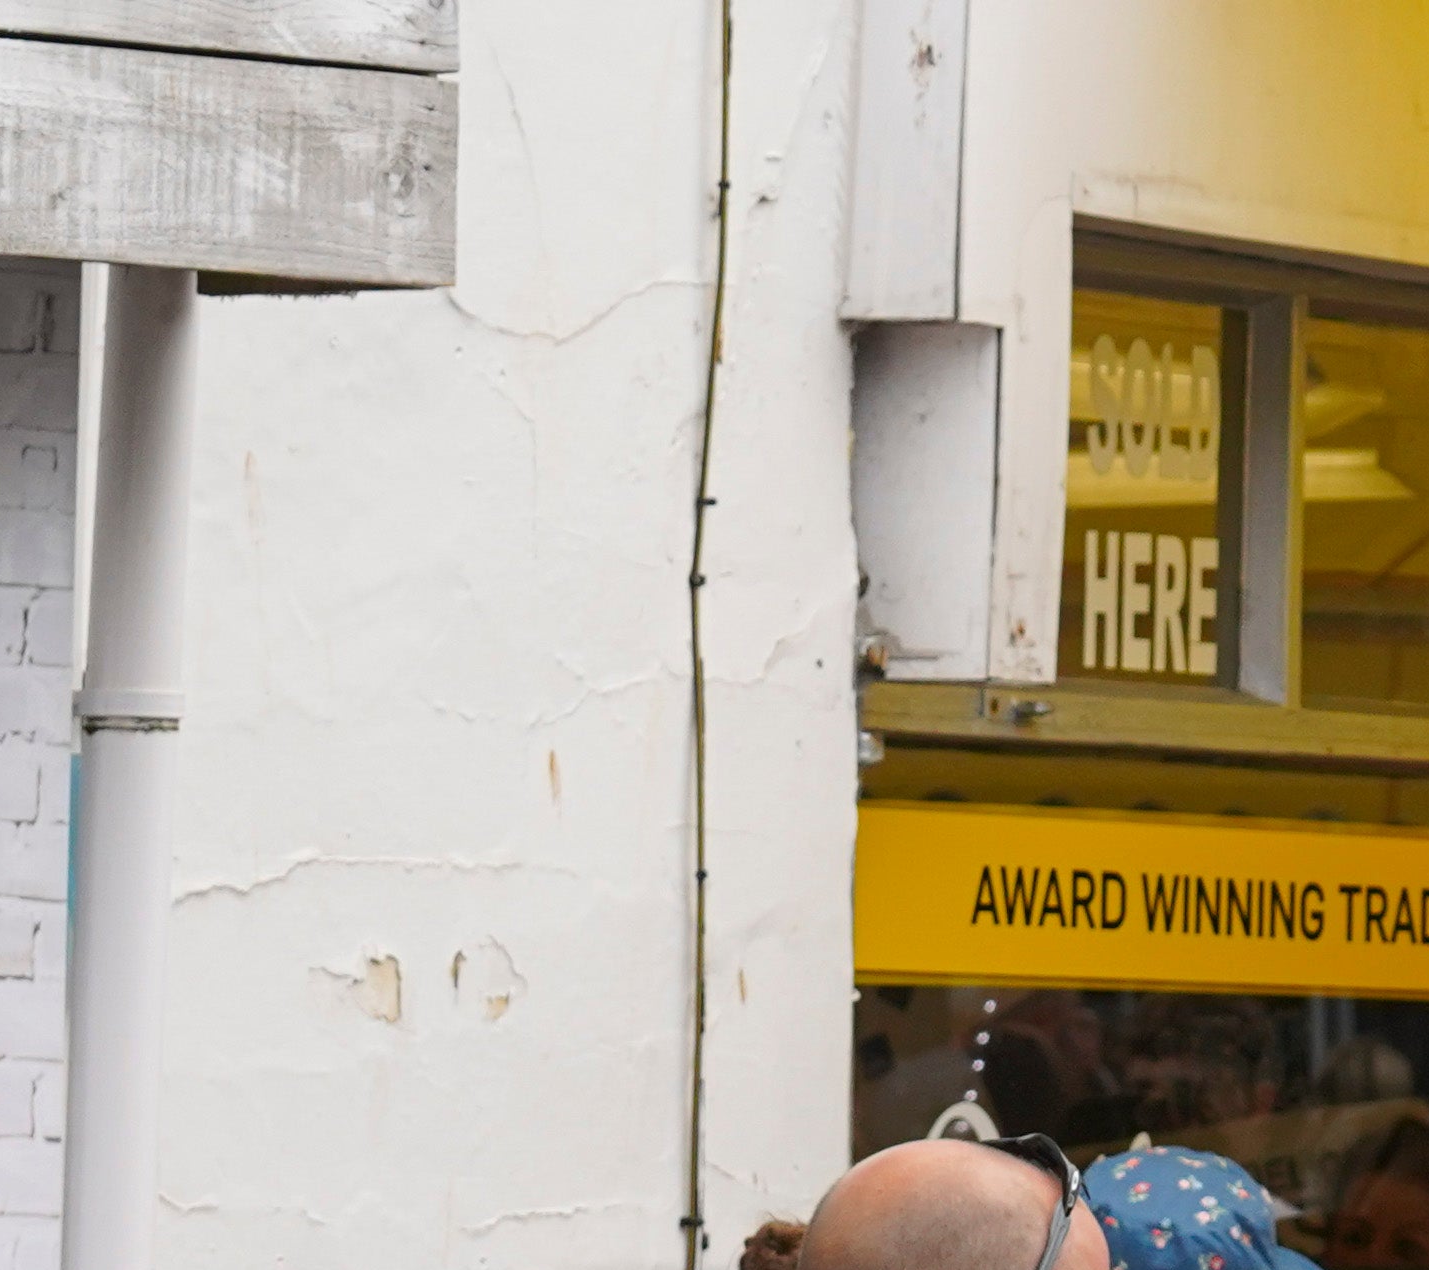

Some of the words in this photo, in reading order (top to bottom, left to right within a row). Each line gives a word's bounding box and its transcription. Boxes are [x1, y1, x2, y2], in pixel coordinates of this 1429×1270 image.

[1086, 333, 1219, 482] SOLD
[1082, 528, 1220, 678] HERE
[971, 865, 1127, 931] AWARD
[1142, 872, 1326, 942] WINNING
